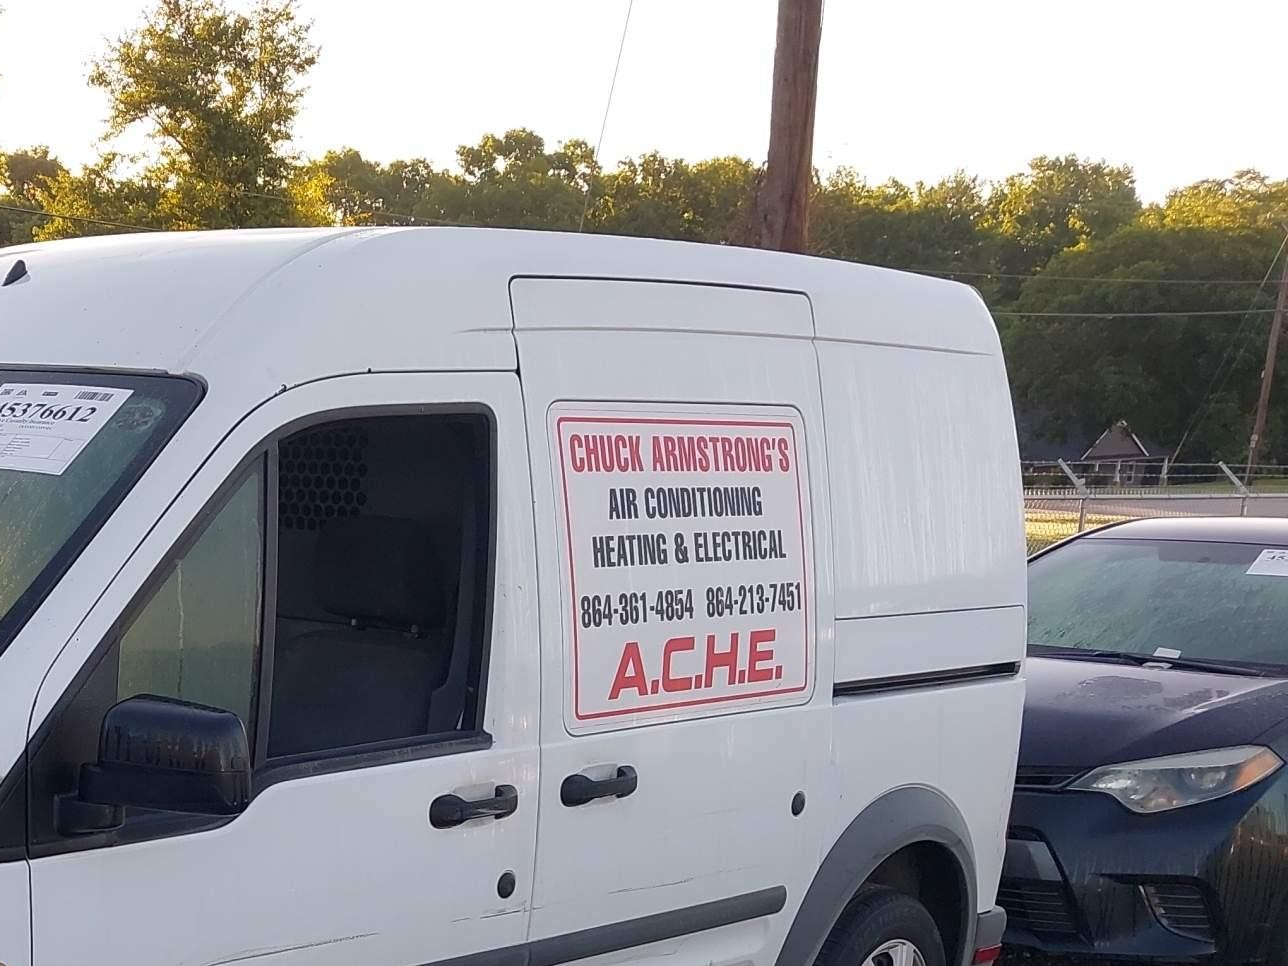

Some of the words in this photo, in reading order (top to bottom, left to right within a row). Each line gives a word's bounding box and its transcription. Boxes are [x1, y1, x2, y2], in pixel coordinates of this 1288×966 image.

[569, 434, 644, 472] CHUCK
[652, 435, 790, 473] ARMSTRONG'S
[609, 487, 639, 520] AIR
[644, 486, 763, 519] CONDITIONING
[592, 533, 667, 568] HEATING
[674, 532, 689, 564] &
[694, 530, 787, 563] ELECTRICAL
[581, 588, 694, 628] 864-361-4854
[706, 581, 802, 618] 864-213-7451
[608, 629, 783, 700] A.C.H.E.
